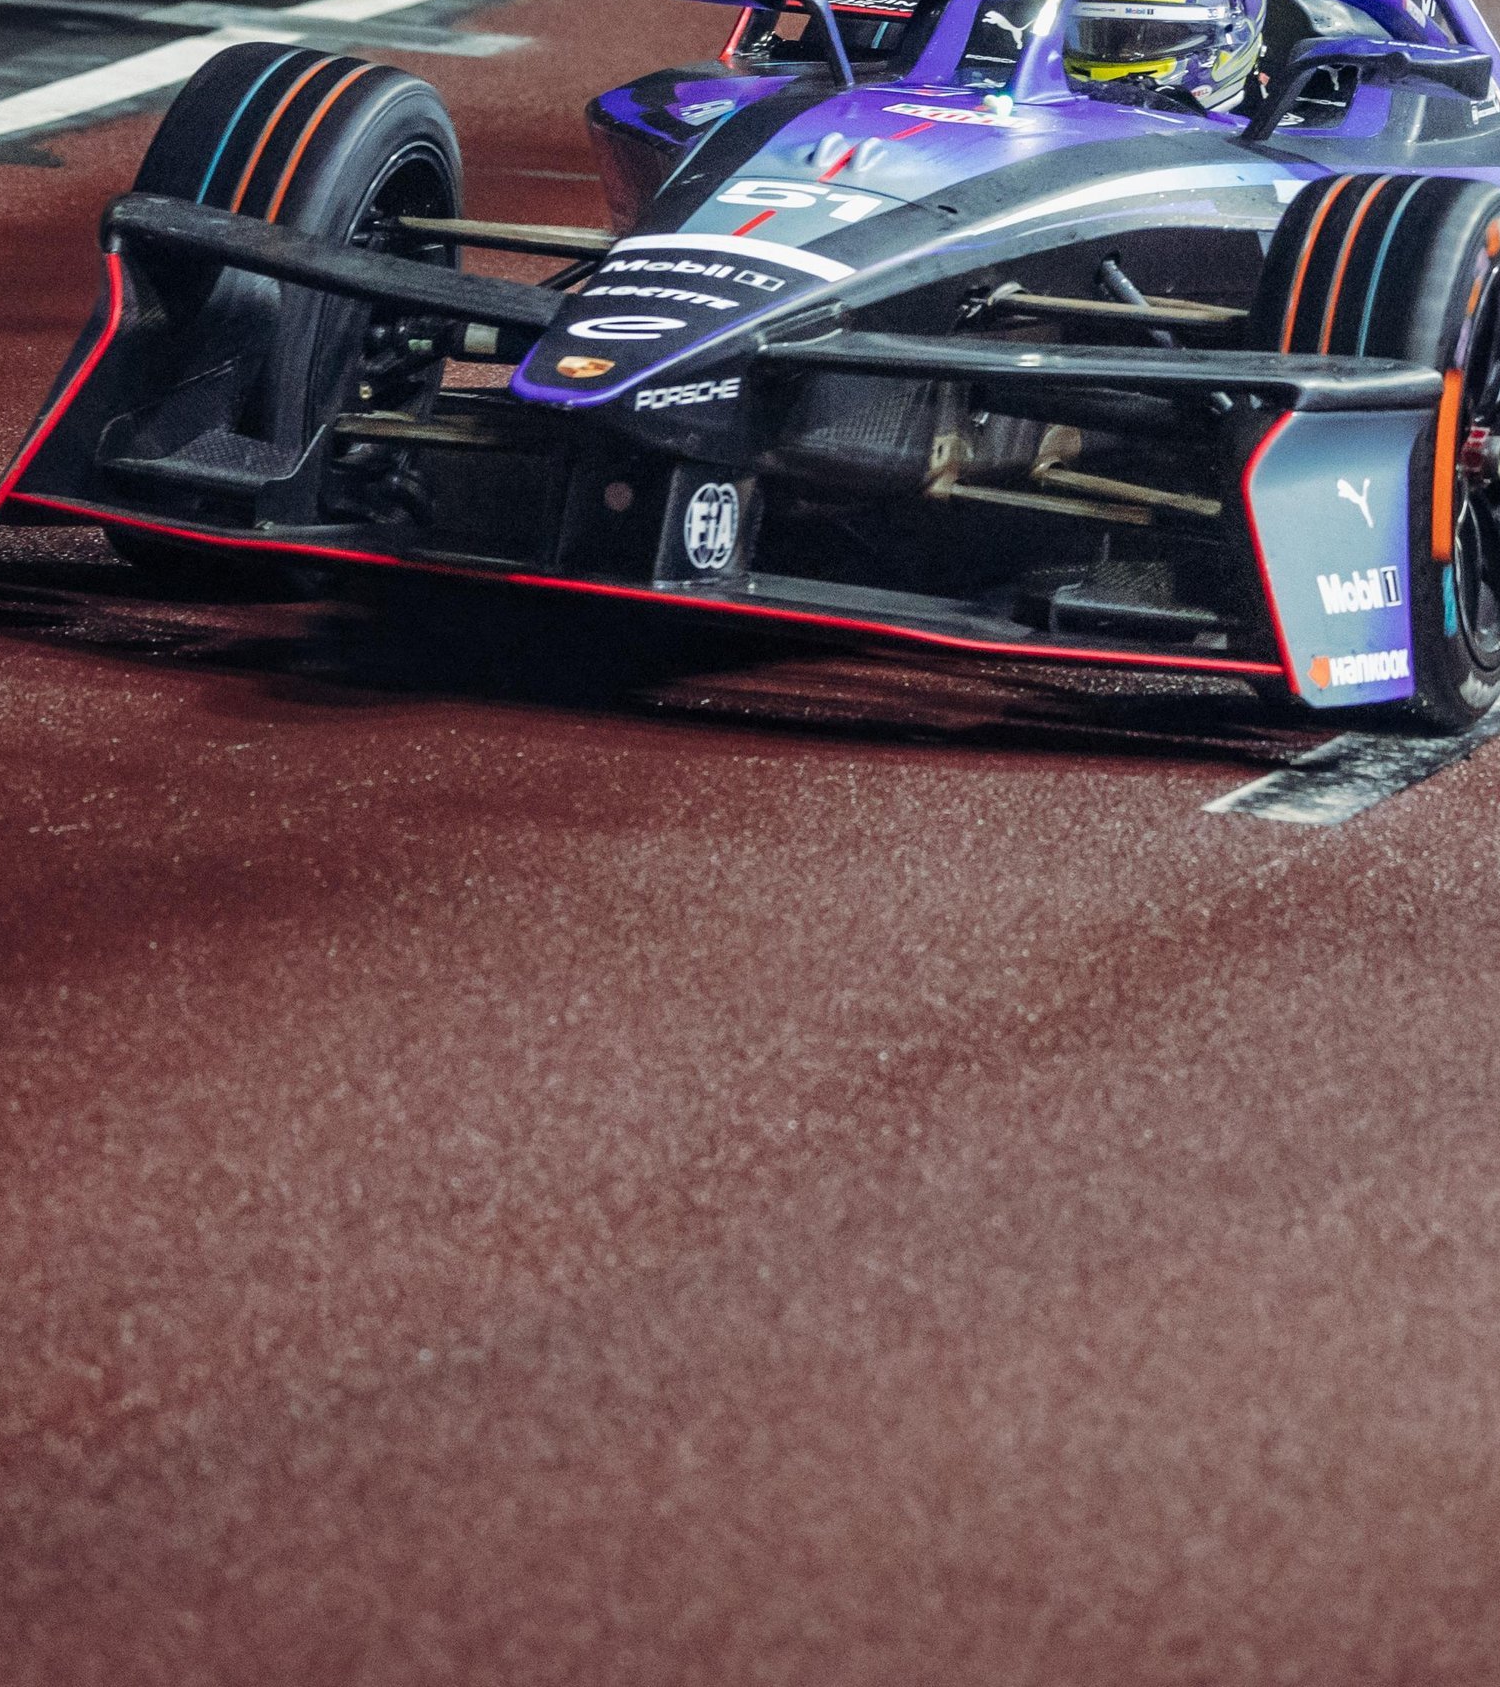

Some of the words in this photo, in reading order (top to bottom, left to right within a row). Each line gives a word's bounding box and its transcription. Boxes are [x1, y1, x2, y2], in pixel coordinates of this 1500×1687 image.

[716, 180, 882, 223] 51
[599, 259, 736, 279] Mobil
[582, 286, 740, 310] LOCTITE
[634, 377, 741, 411] PORSCHE
[1316, 568, 1384, 615] Mobil
